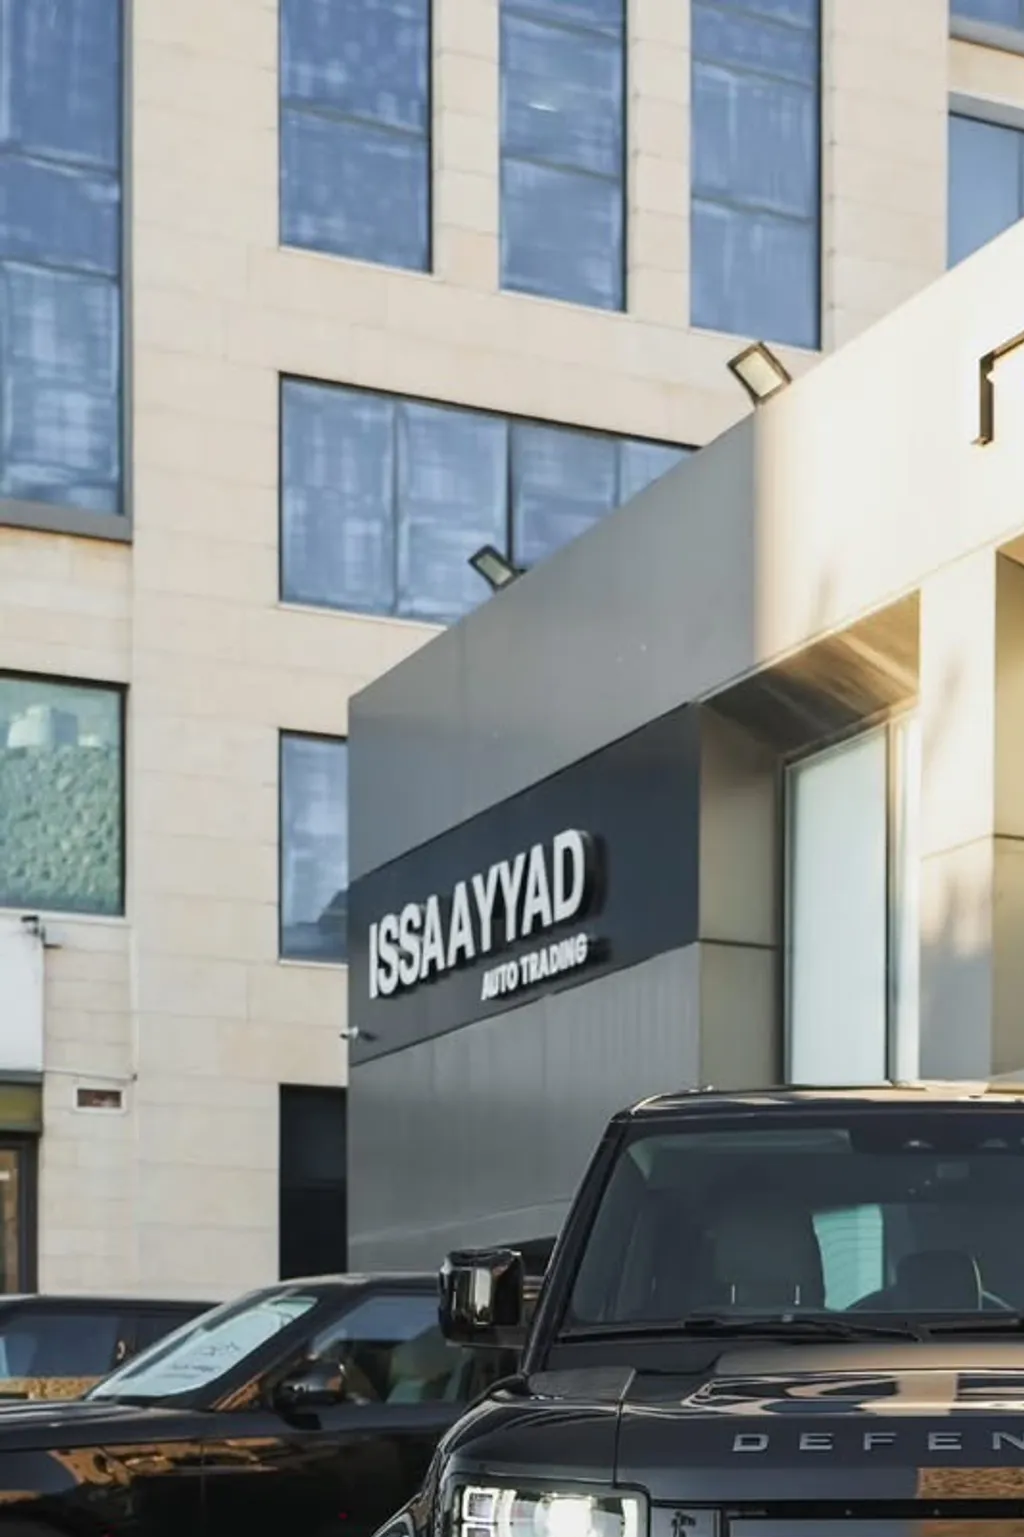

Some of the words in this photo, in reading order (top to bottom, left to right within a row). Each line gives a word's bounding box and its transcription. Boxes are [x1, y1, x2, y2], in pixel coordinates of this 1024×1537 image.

[368, 894, 446, 999] ISSA
[447, 828, 588, 966] AYYAD
[480, 960, 520, 1001] AUTO
[520, 932, 590, 985] TRADING
